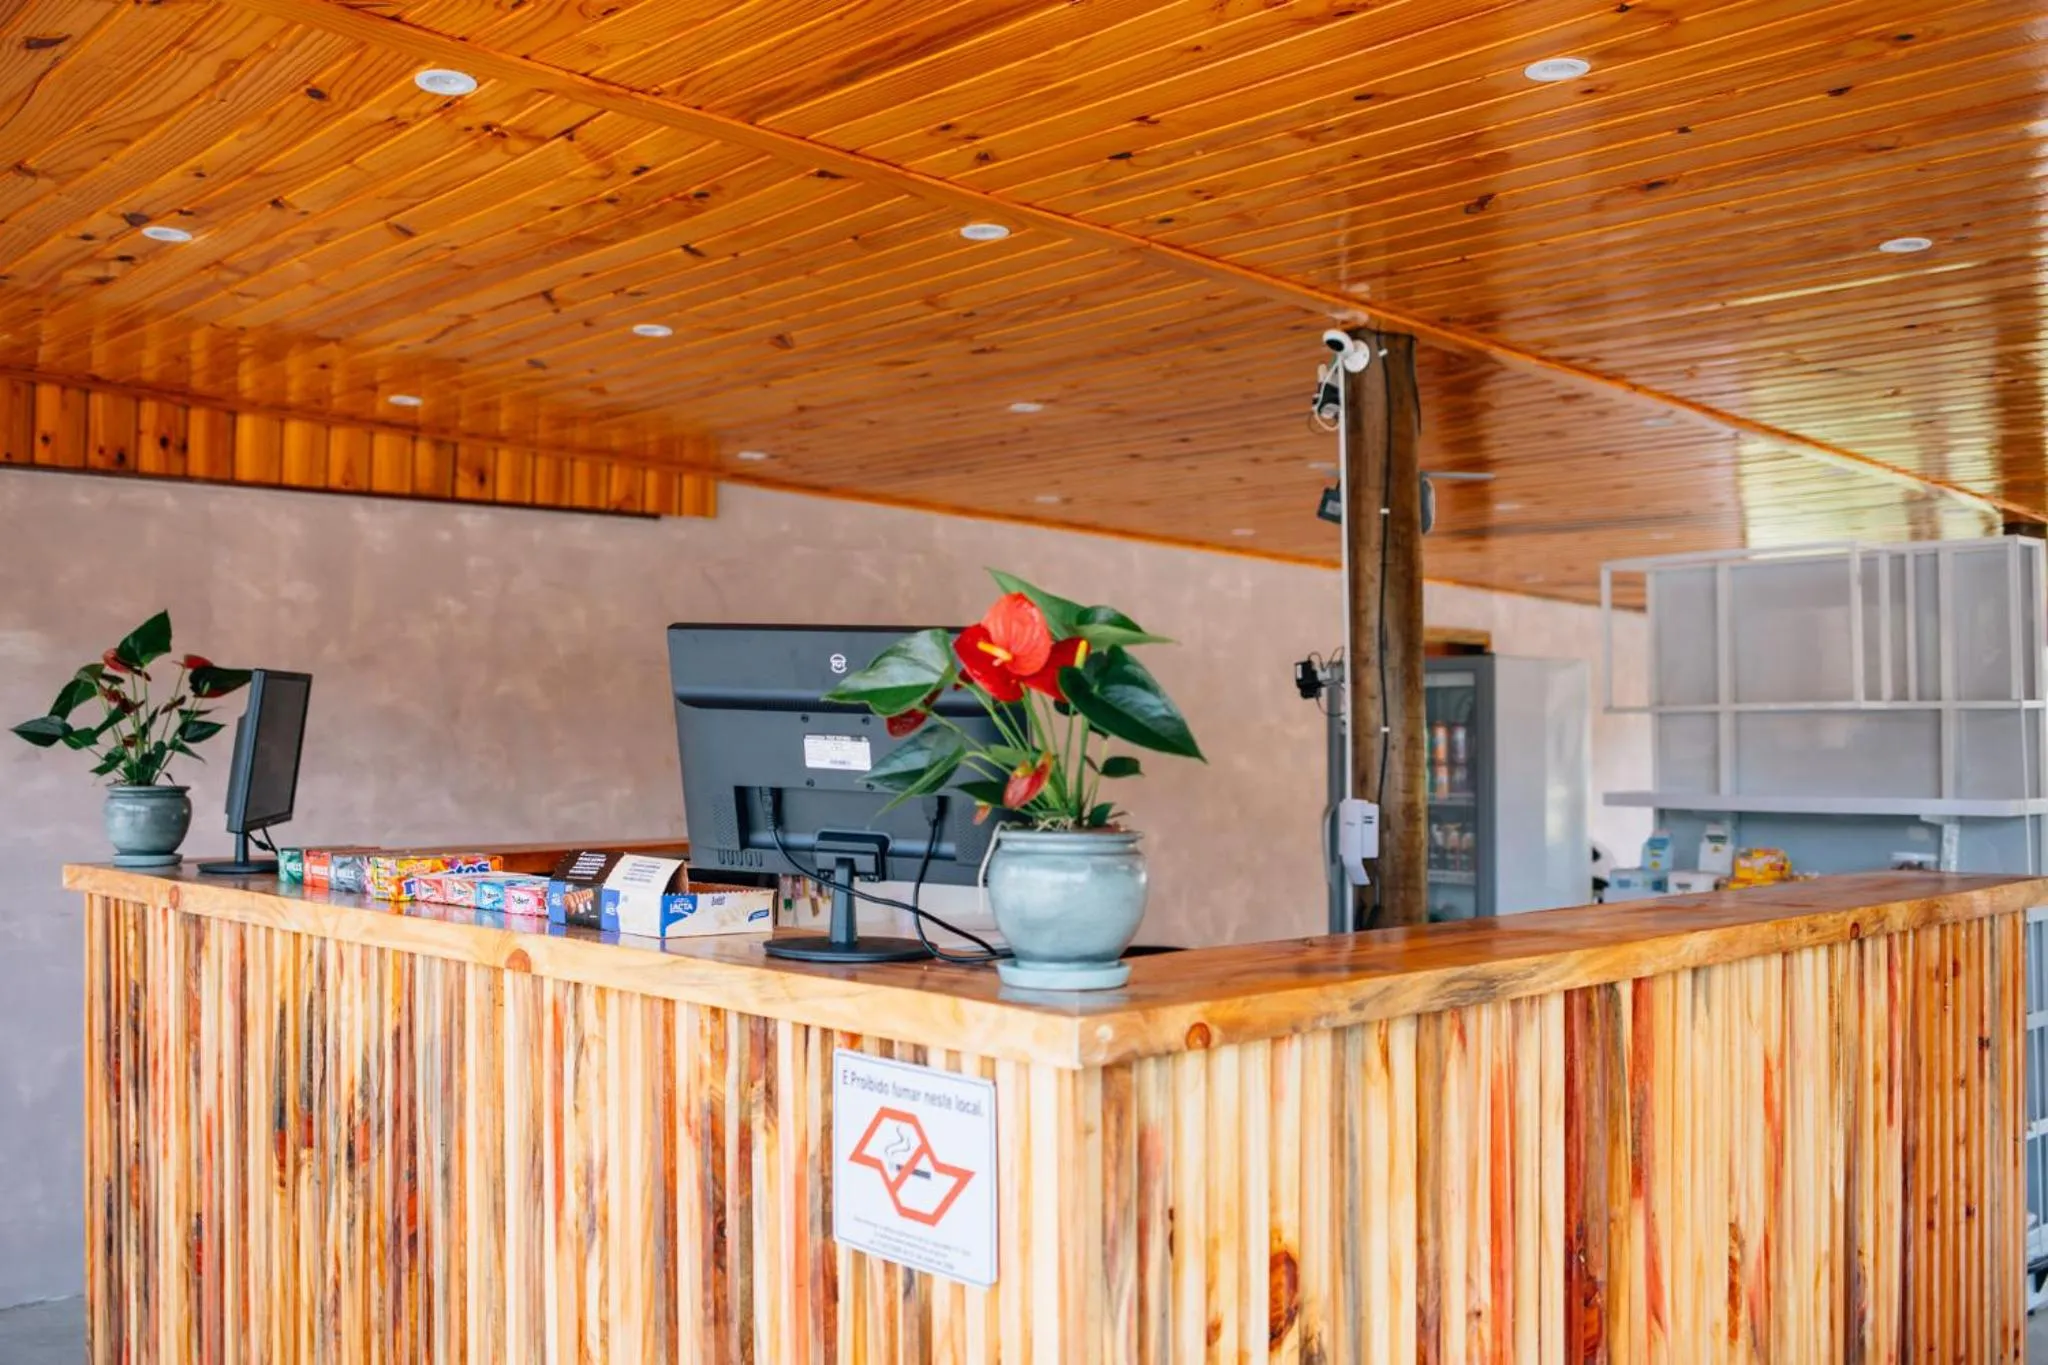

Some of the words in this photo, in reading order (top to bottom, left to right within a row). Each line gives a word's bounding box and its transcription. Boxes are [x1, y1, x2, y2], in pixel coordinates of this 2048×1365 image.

[851, 1071, 889, 1096] Proibido
[892, 1081, 921, 1102] fumar
[924, 1091, 952, 1111] neste
